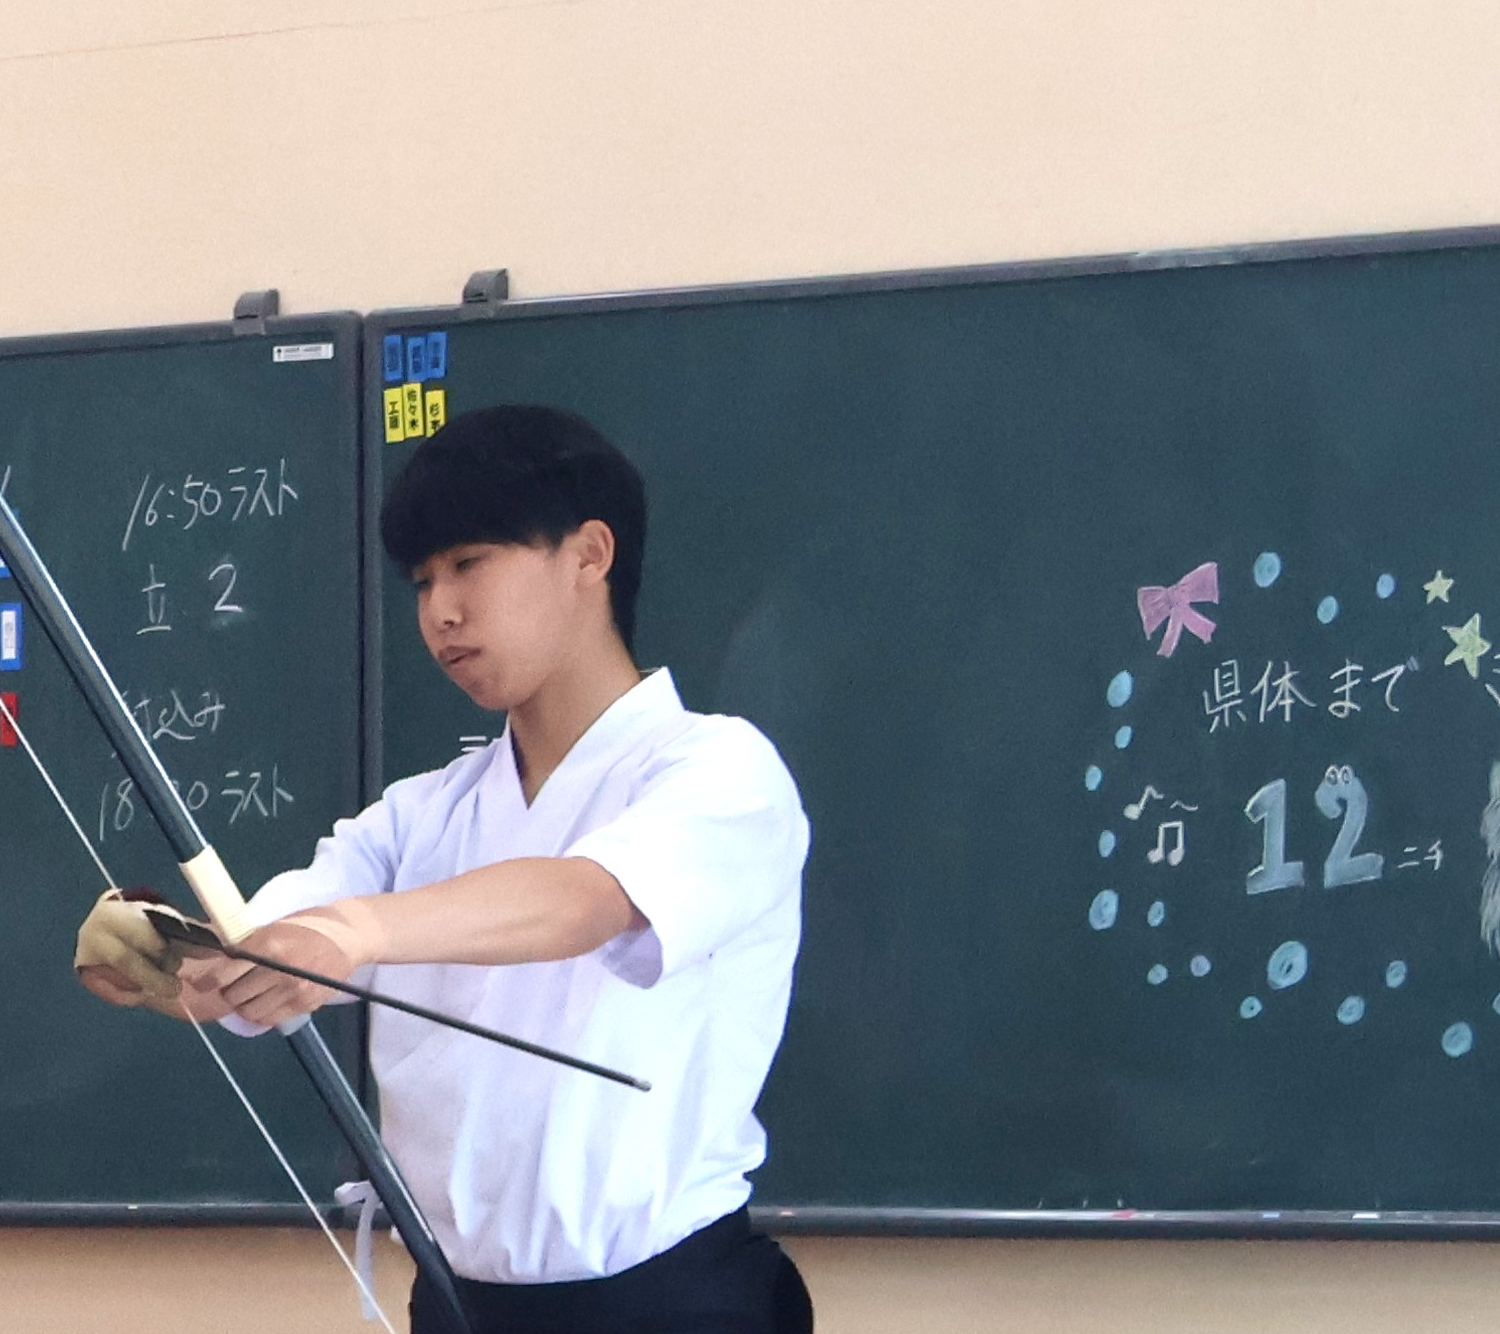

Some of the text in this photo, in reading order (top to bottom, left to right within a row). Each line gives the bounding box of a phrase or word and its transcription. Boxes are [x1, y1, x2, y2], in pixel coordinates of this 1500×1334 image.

[122, 458, 299, 551] 16:50 ラスト
[136, 563, 244, 635] 立 2
[1202, 656, 1420, 734] 県体まで
[99, 765, 294, 843] 180 ラスト
[1243, 764, 1385, 896] 12
